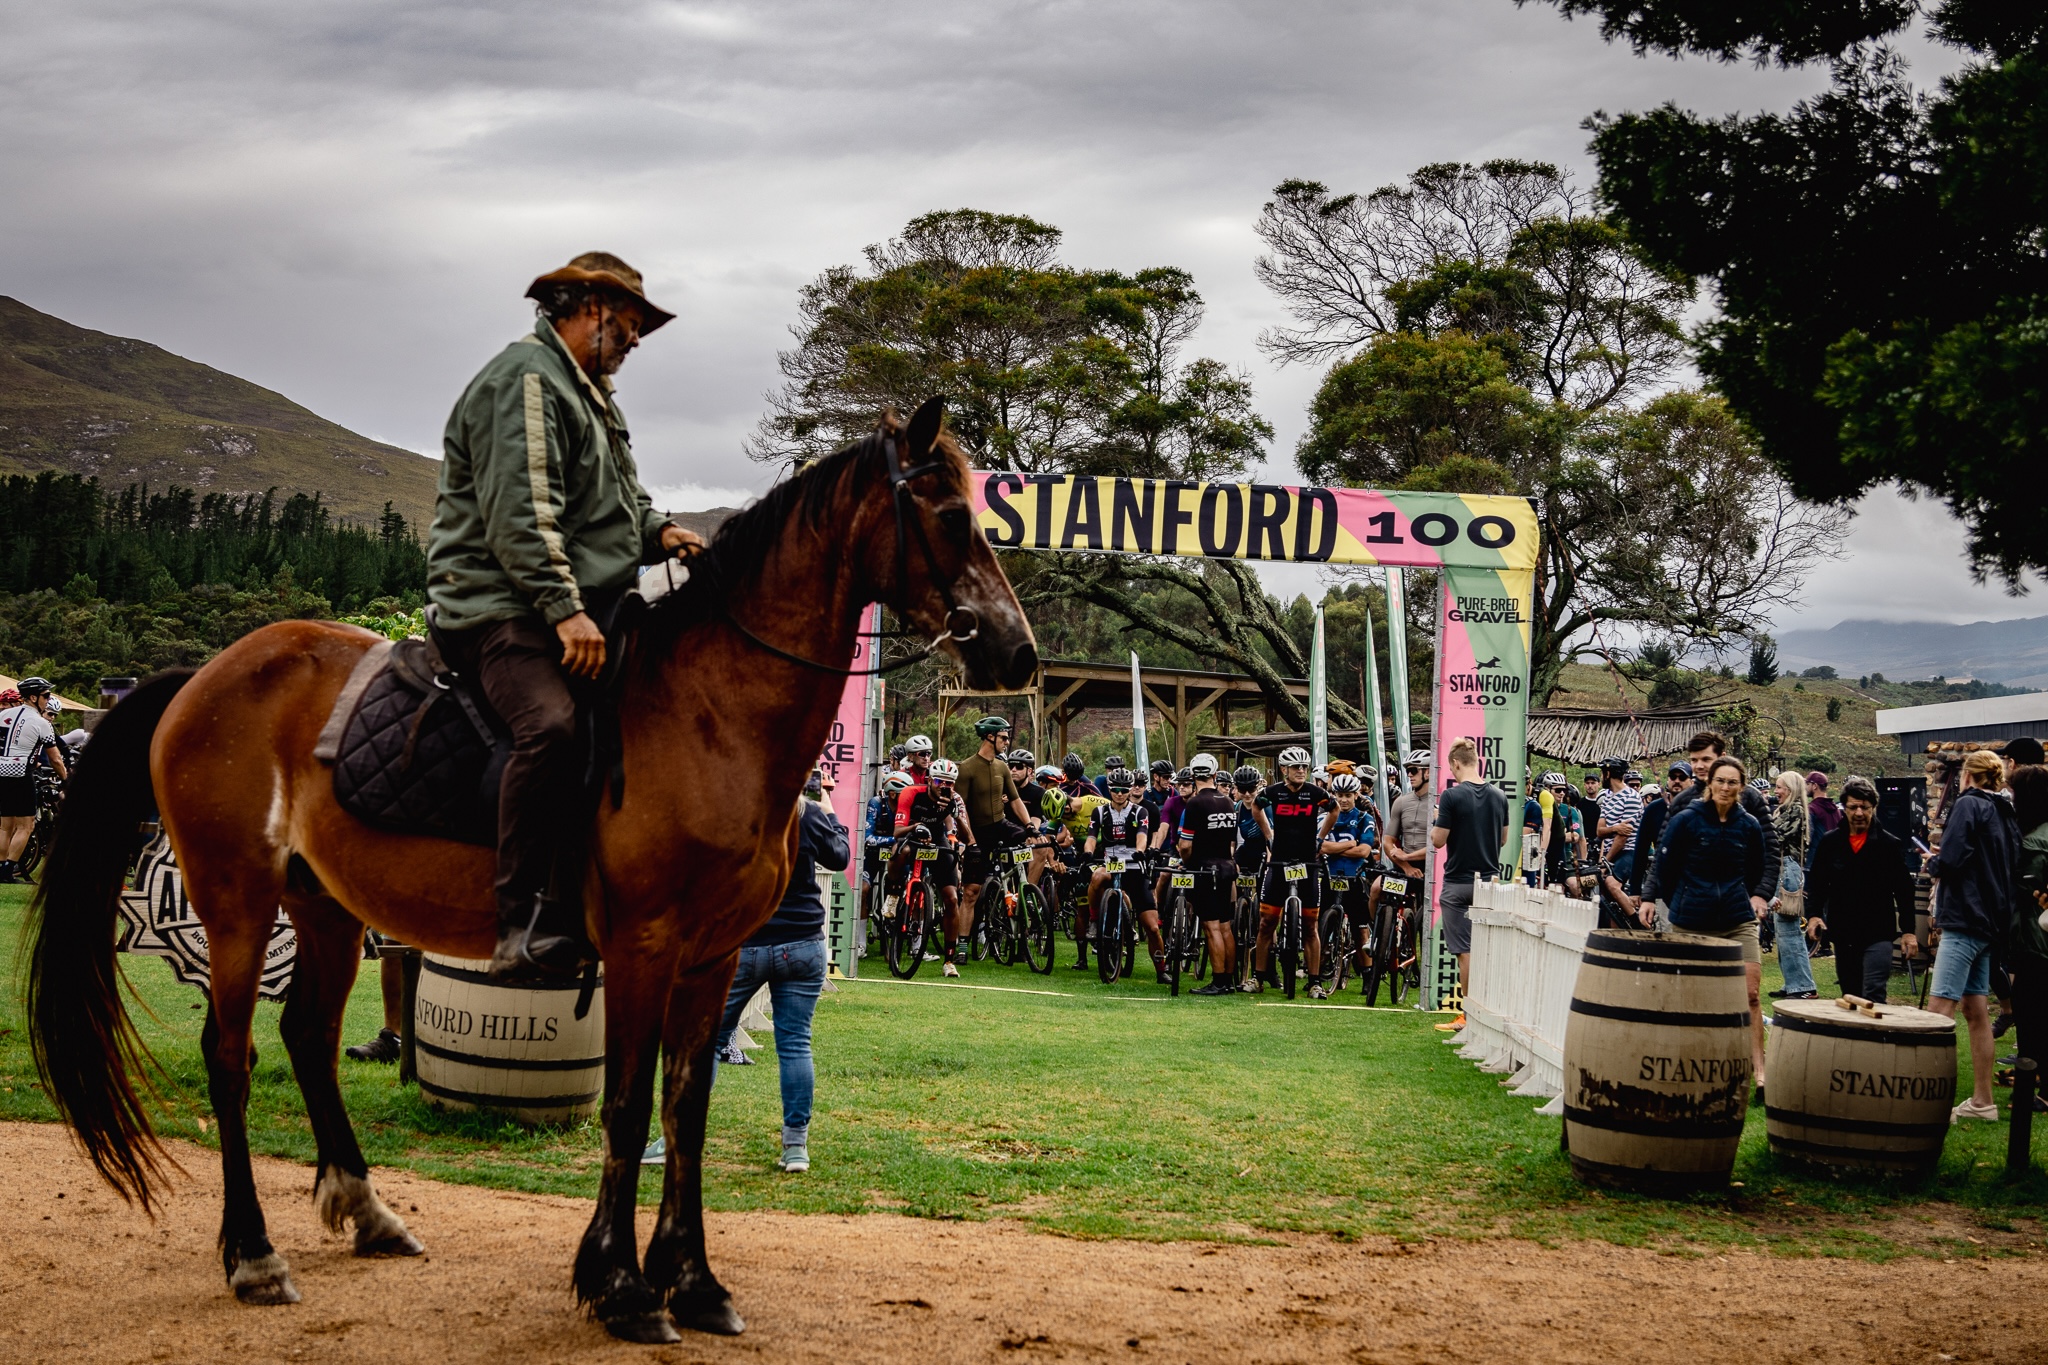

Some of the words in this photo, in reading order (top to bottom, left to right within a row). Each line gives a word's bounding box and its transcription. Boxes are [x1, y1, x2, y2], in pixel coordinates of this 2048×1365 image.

[983, 474, 1339, 562] STANFORD
[1366, 511, 1516, 549] 100
[1457, 596, 1519, 612] PURE-BRED
[1448, 609, 1526, 624] GRAVEL
[1449, 674, 1521, 693] STANFORD
[1463, 695, 1507, 706] 100
[1087, 796, 1107, 806] TOYO
[1275, 804, 1313, 816] BH
[1015, 852, 1031, 862] 192
[1108, 863, 1124, 871] 175
[831, 881, 841, 890] HE
[1175, 878, 1192, 886] 162
[1386, 881, 1404, 892] 220
[416, 996, 473, 1036] NFORD
[479, 1014, 558, 1042] HILLS
[1829, 1069, 1948, 1101] STANFORD
